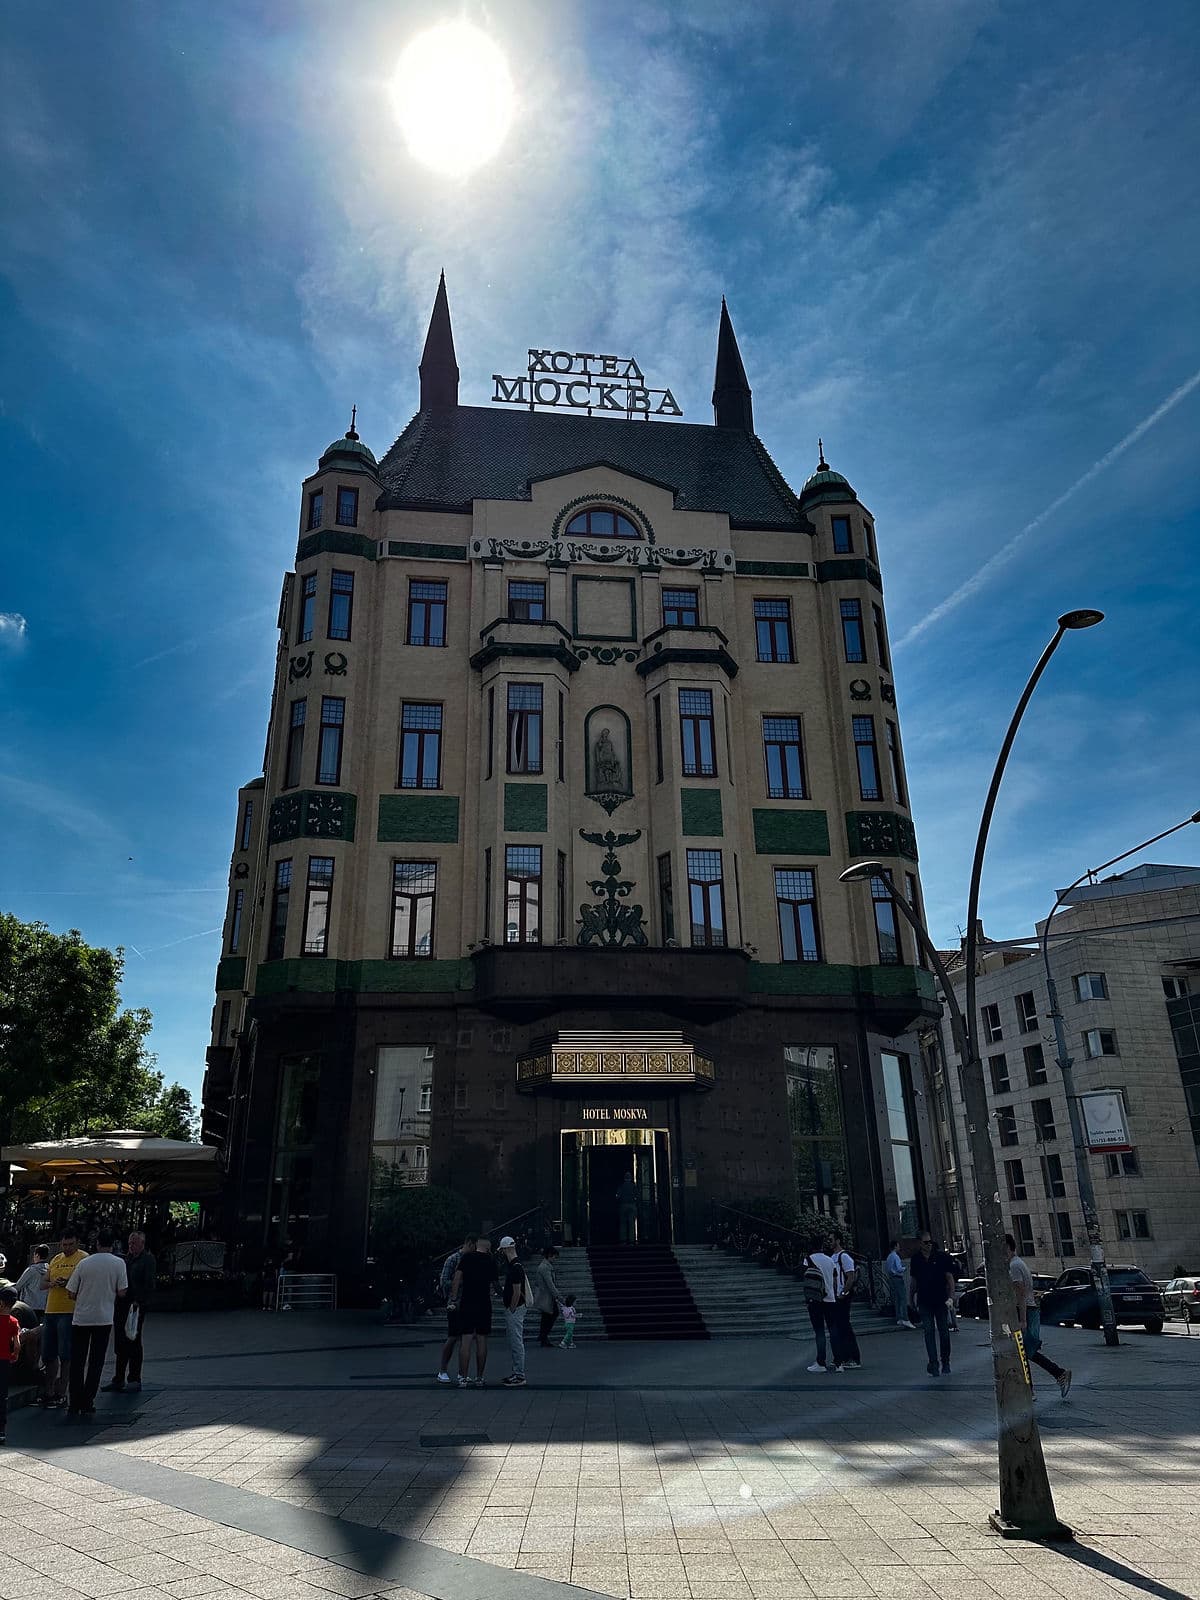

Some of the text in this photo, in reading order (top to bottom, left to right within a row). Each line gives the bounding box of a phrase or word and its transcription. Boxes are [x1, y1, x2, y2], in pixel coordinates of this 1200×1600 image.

[528, 349, 644, 379] ХОТЕЛ
[492, 374, 683, 416] МОСКВА
[583, 1108, 647, 1119] HOTEL MOSKVA
